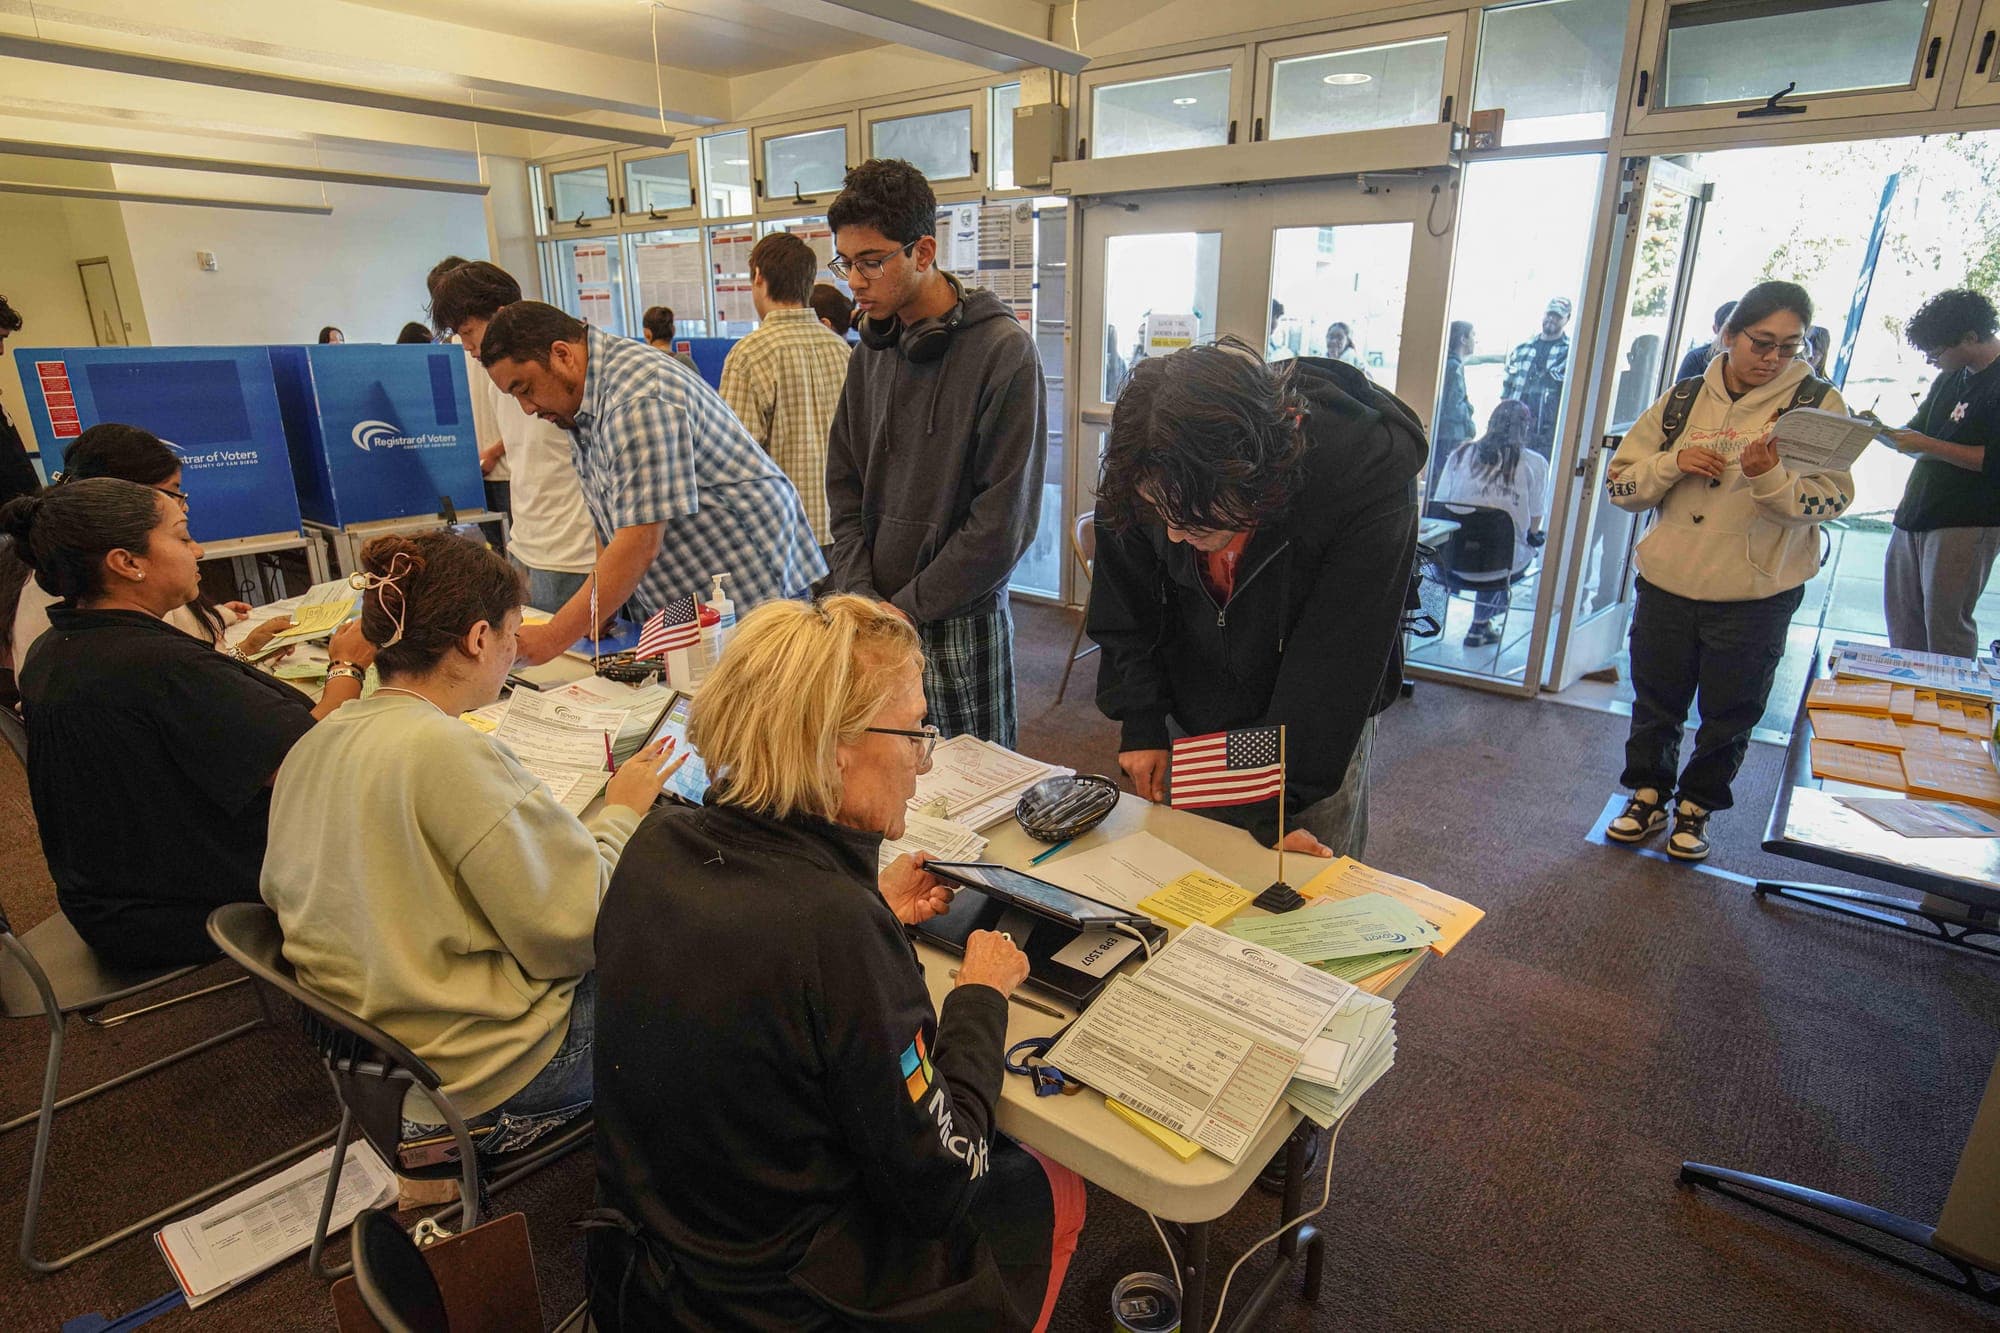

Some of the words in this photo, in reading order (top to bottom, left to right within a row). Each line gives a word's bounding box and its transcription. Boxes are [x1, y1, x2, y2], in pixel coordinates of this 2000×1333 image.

[374, 436, 415, 448] Registrar
[416, 434, 426, 443] of
[427, 434, 457, 442] Voters
[181, 454, 205, 465] strar
[206, 451, 218, 462] of
[220, 450, 258, 461] Voters
[1099, 937, 1119, 951] EPB
[1081, 949, 1104, 967] 1507
